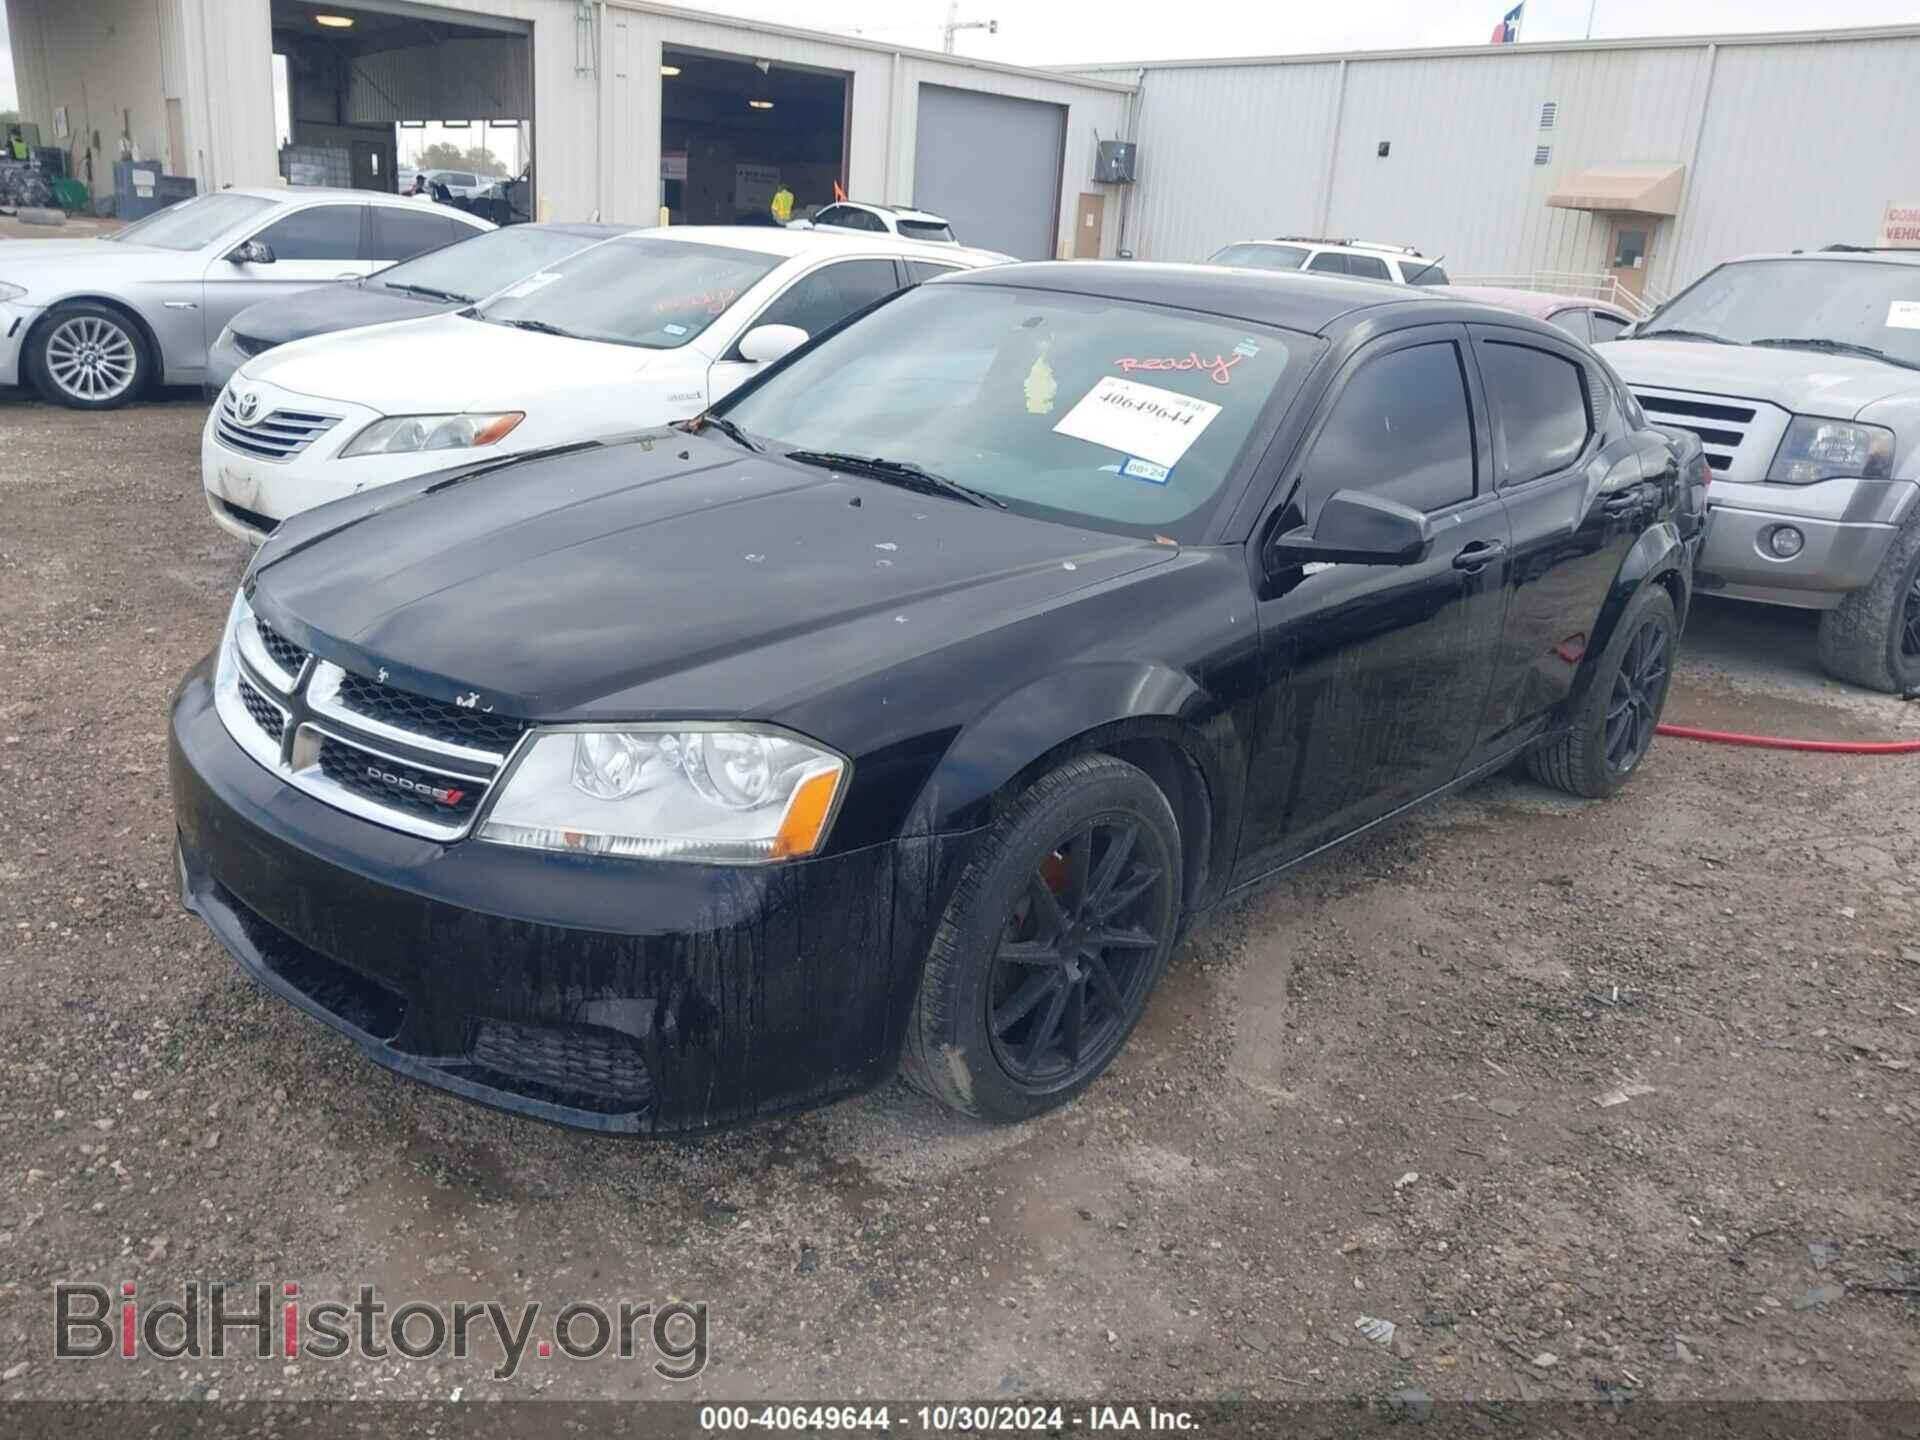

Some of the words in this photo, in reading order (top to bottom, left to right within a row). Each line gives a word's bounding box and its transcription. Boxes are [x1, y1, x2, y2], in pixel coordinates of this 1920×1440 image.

[1113, 351, 1242, 384] Ready
[1099, 391, 1194, 425] 40649644
[367, 766, 449, 800] DODGE
